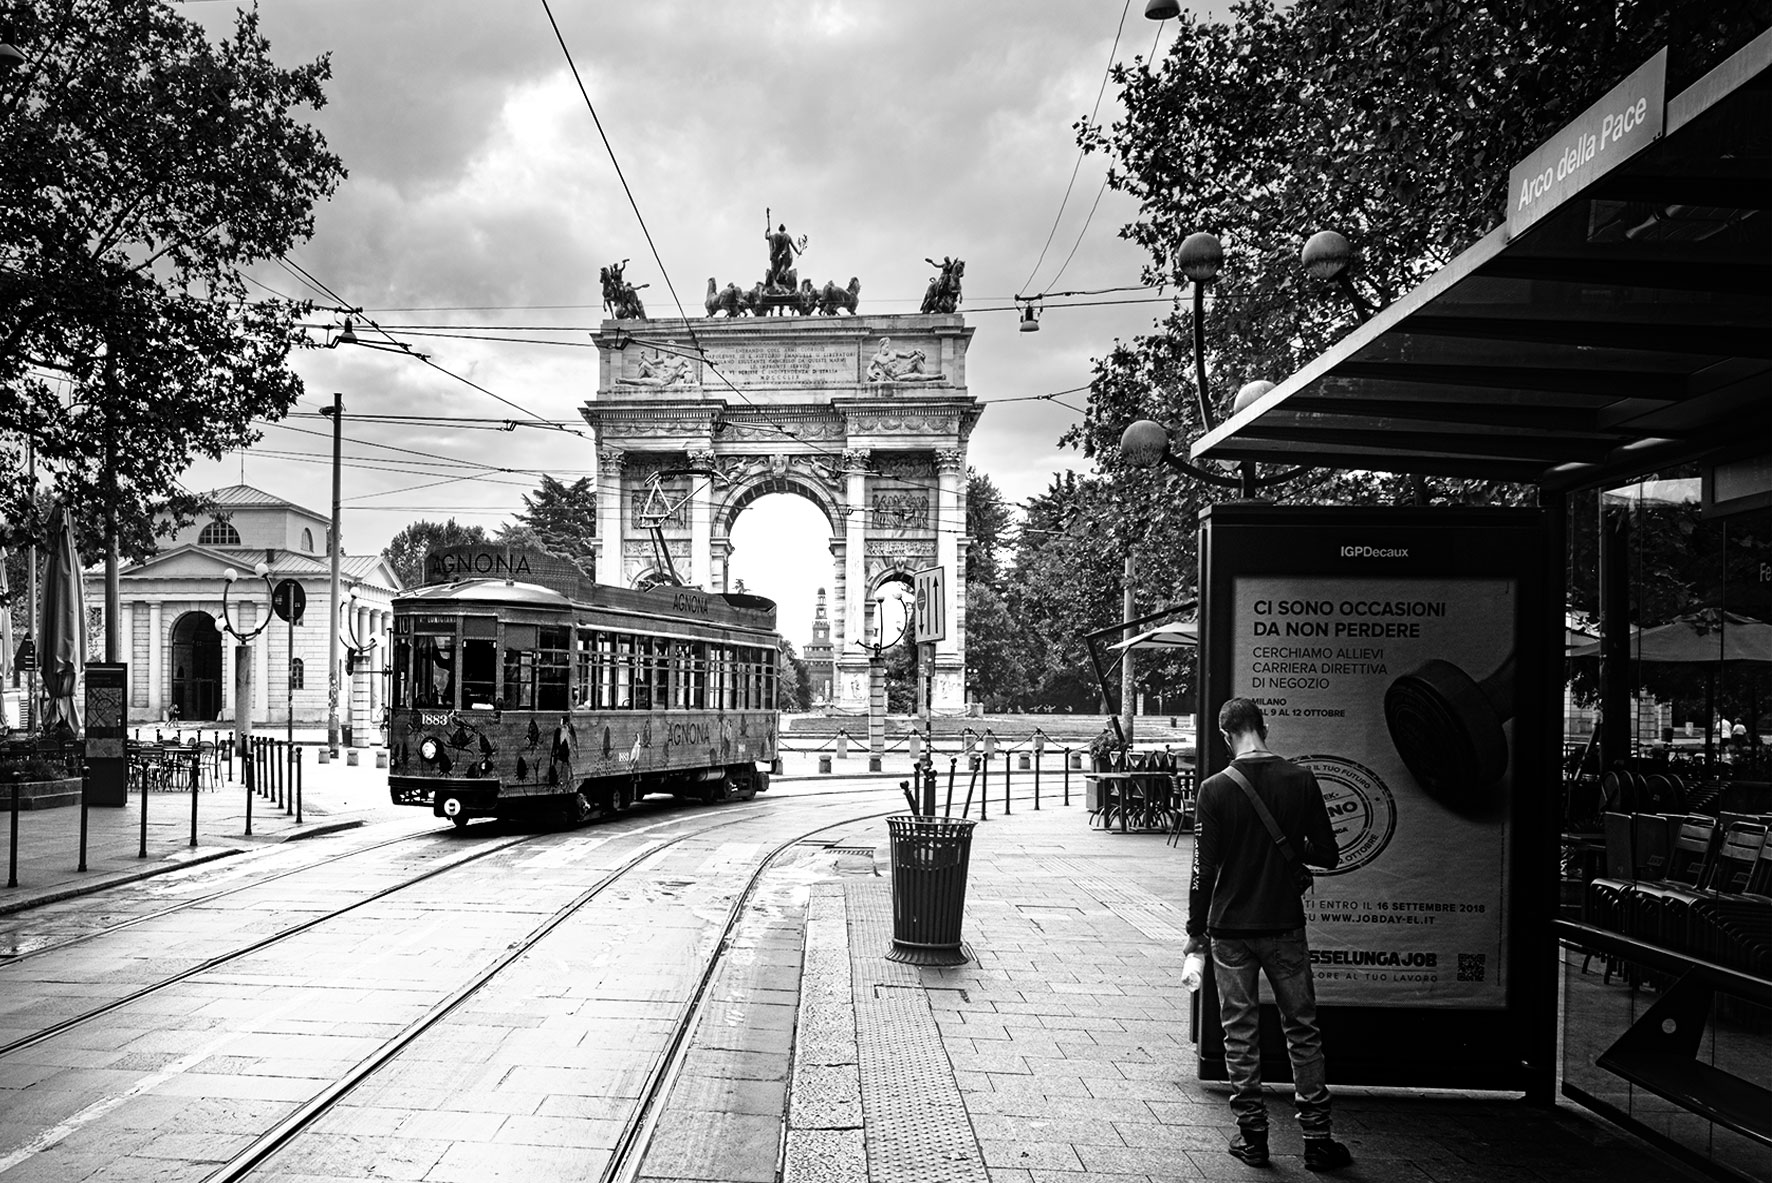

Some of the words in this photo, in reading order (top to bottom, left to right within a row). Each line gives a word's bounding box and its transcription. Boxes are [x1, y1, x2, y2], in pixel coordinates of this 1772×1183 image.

[1517, 167, 1553, 211] Arco
[1556, 132, 1596, 181] della
[1600, 97, 1647, 151] Pace
[1340, 545, 1409, 558] IGPDecaux
[433, 553, 531, 574] AGNONA
[672, 593, 708, 615] AGNONA
[1254, 600, 1272, 615] CI
[1278, 600, 1334, 615] SONO
[1339, 601, 1446, 617] OCCASIONI
[1254, 622, 1280, 636] DA
[1286, 622, 1329, 637] NON
[1335, 622, 1420, 638] PERDERE
[1252, 647, 1333, 659] CERCHIAMO
[1336, 648, 1384, 660] ALLIEVI
[1252, 662, 1317, 674] CARRIERA
[1321, 663, 1388, 675] DIRETTIVA
[1252, 677, 1265, 688] DI
[1269, 677, 1330, 689] NEGOZIO
[1252, 697, 1287, 706] MILANO
[422, 713, 448, 726] 1883
[1270, 708, 1277, 717] 9
[1278, 708, 1290, 717] AL
[1292, 708, 1302, 717] 12
[1303, 708, 1346, 718] OTTOBRE
[668, 723, 710, 746] AGNONA
[1322, 764, 1341, 773] TUO
[1341, 769, 1371, 790] FUTURO
[1345, 834, 1379, 861] OTTOBRE
[1319, 900, 1359, 910] ENTRO
[1362, 901, 1372, 910] IL
[1377, 902, 1389, 911] 16
[1392, 902, 1456, 912] SETTEMBRE
[1459, 903, 1486, 913] 2018
[1321, 914, 1436, 925] WWW.JOBDAY-EL.IT
[1345, 972, 1359, 980] AL
[1365, 973, 1388, 981] TUO
[1393, 974, 1438, 982] LAVORO
